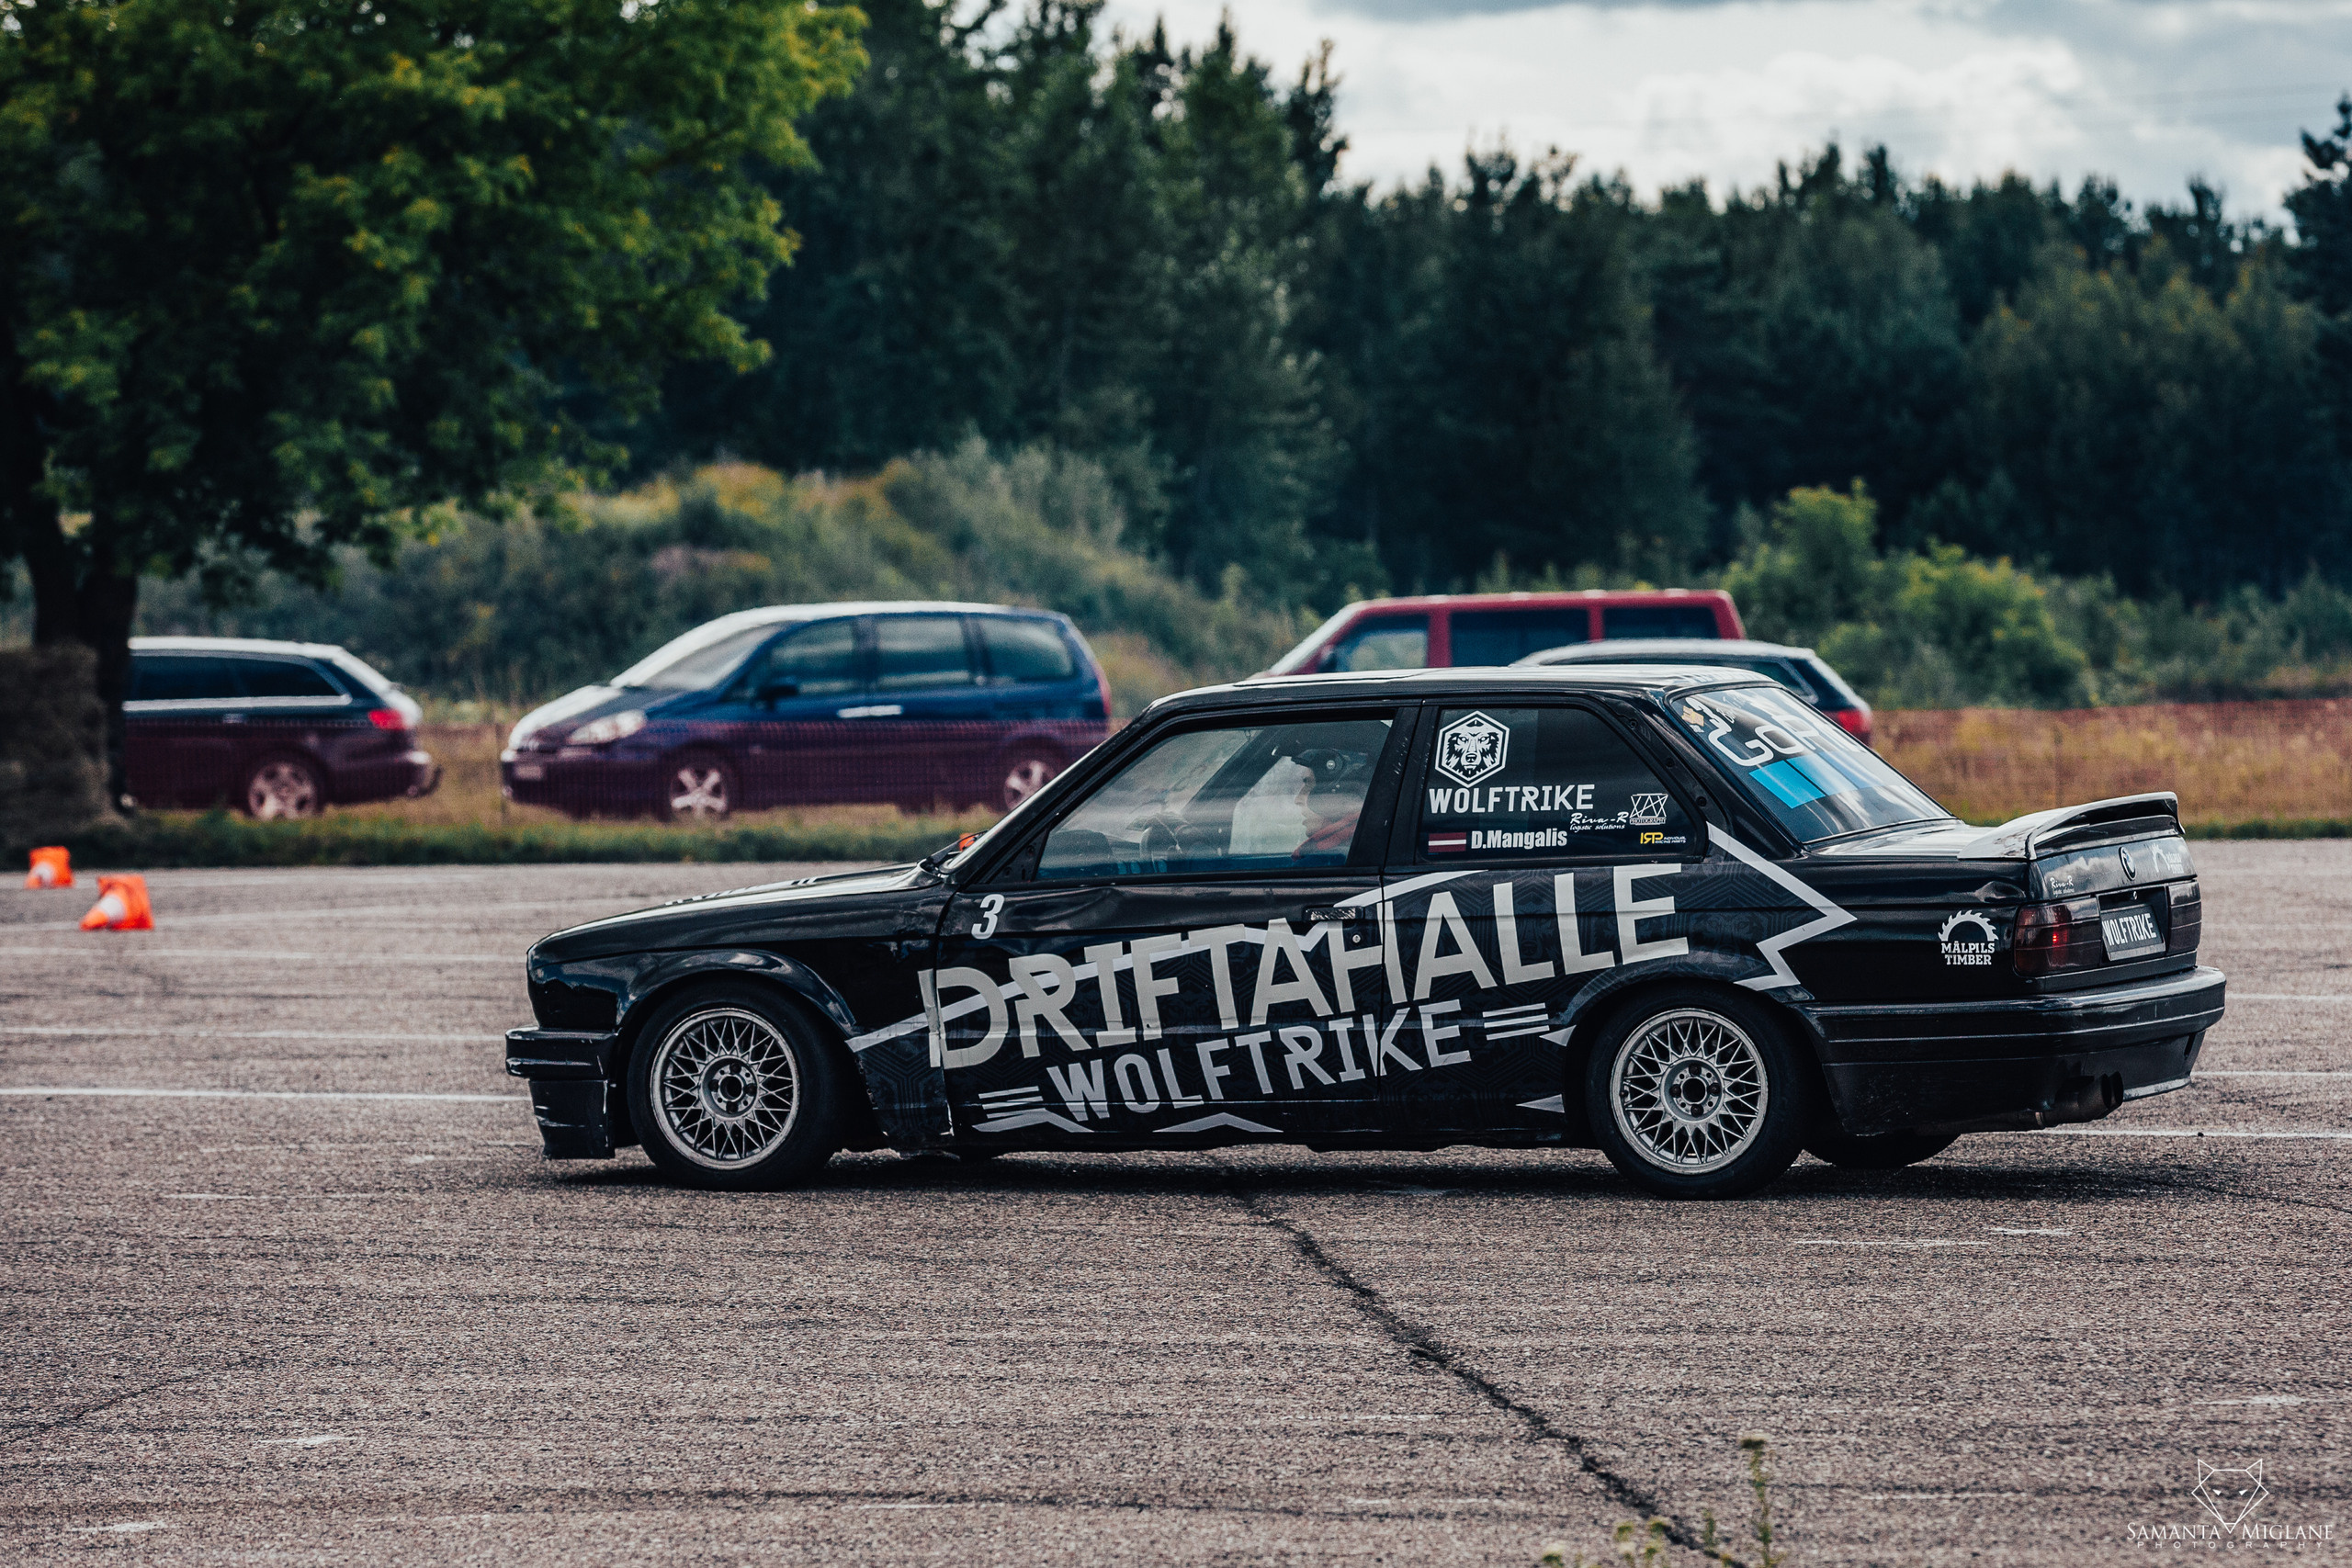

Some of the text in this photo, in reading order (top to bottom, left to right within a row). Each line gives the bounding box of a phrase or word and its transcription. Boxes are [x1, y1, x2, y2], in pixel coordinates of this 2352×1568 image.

[1429, 784, 1595, 814] WOLFTRIKE
[1471, 828, 1567, 850] D.Mangalis
[971, 894, 1004, 940] 3
[2102, 913, 2157, 946] WOLFTRIKE
[917, 863, 1690, 1070] DRIFTAHALLE
[1944, 953, 1992, 965] TIMBER
[1046, 998, 1472, 1122] WOLFTRIKE
